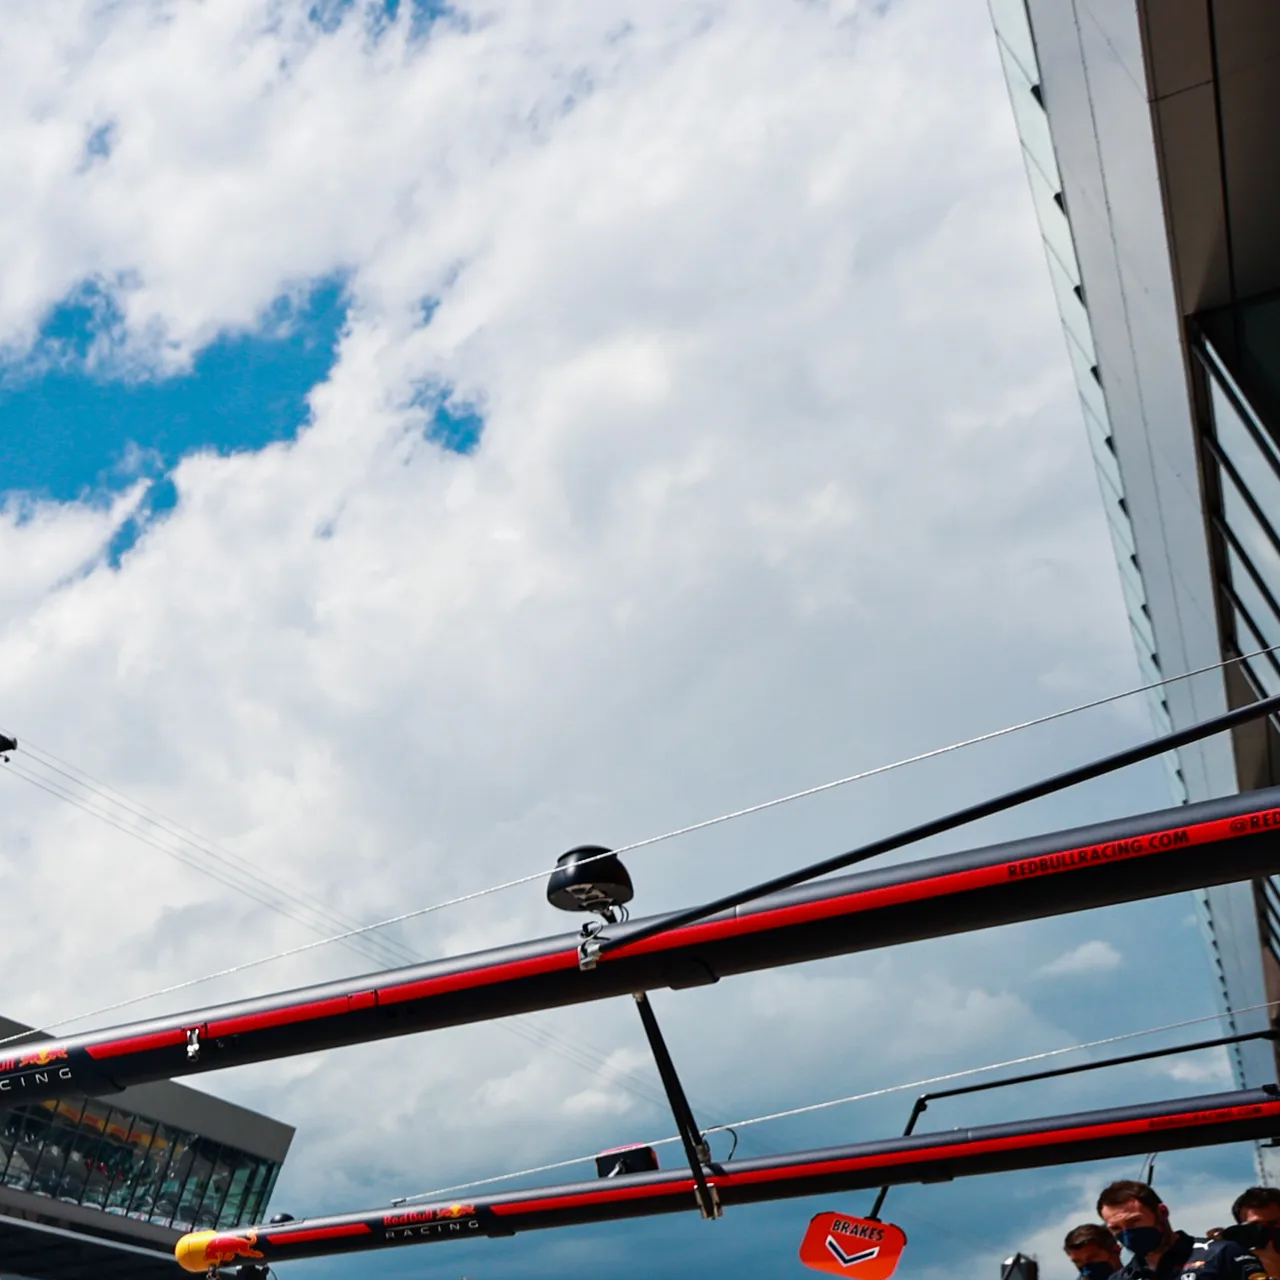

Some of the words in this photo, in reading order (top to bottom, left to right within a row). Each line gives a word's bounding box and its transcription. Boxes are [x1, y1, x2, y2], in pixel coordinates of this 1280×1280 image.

[1007, 828, 1189, 878] REDBULLRACING.COM
[385, 1220, 479, 1239] RACING
[831, 1219, 885, 1241] BRAKES
